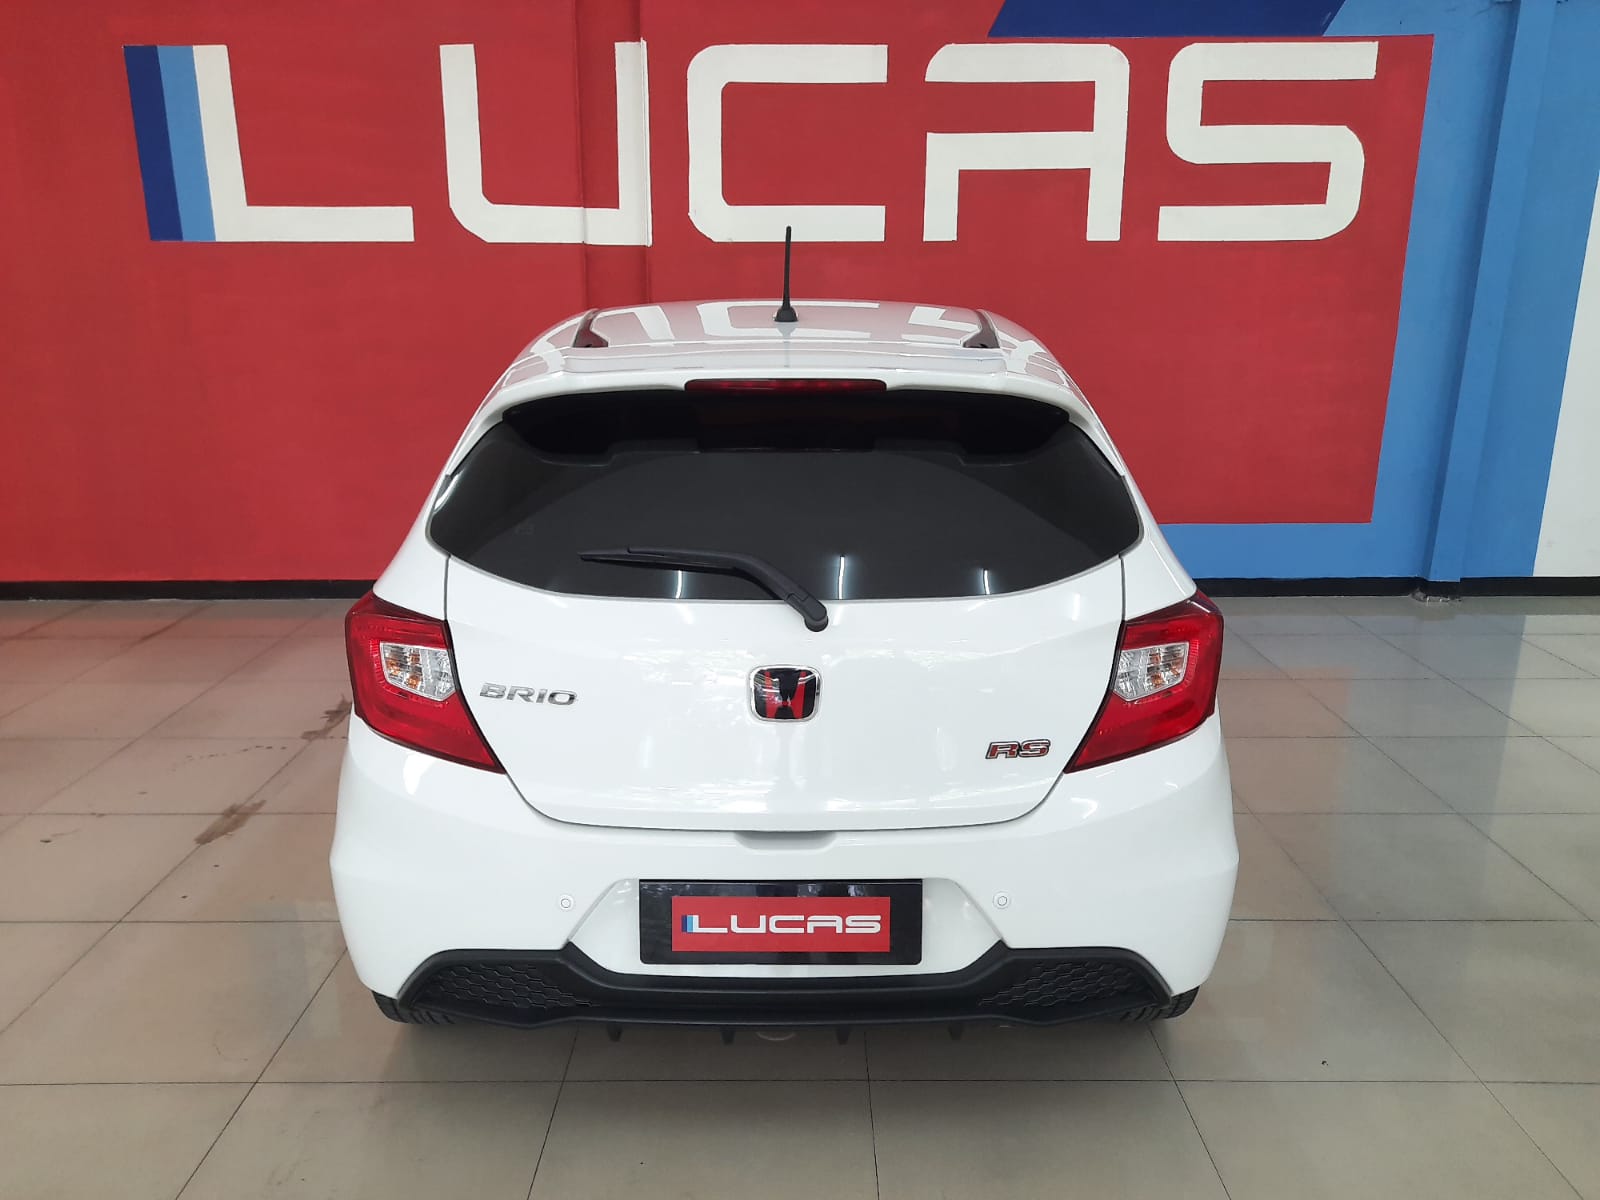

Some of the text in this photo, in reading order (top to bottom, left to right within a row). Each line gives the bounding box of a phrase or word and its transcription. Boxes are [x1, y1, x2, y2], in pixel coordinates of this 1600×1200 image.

[192, 39, 1379, 246] LUCAS
[479, 682, 578, 706] BRIO
[985, 738, 1051, 760] RS
[692, 914, 882, 934] LUCAS
